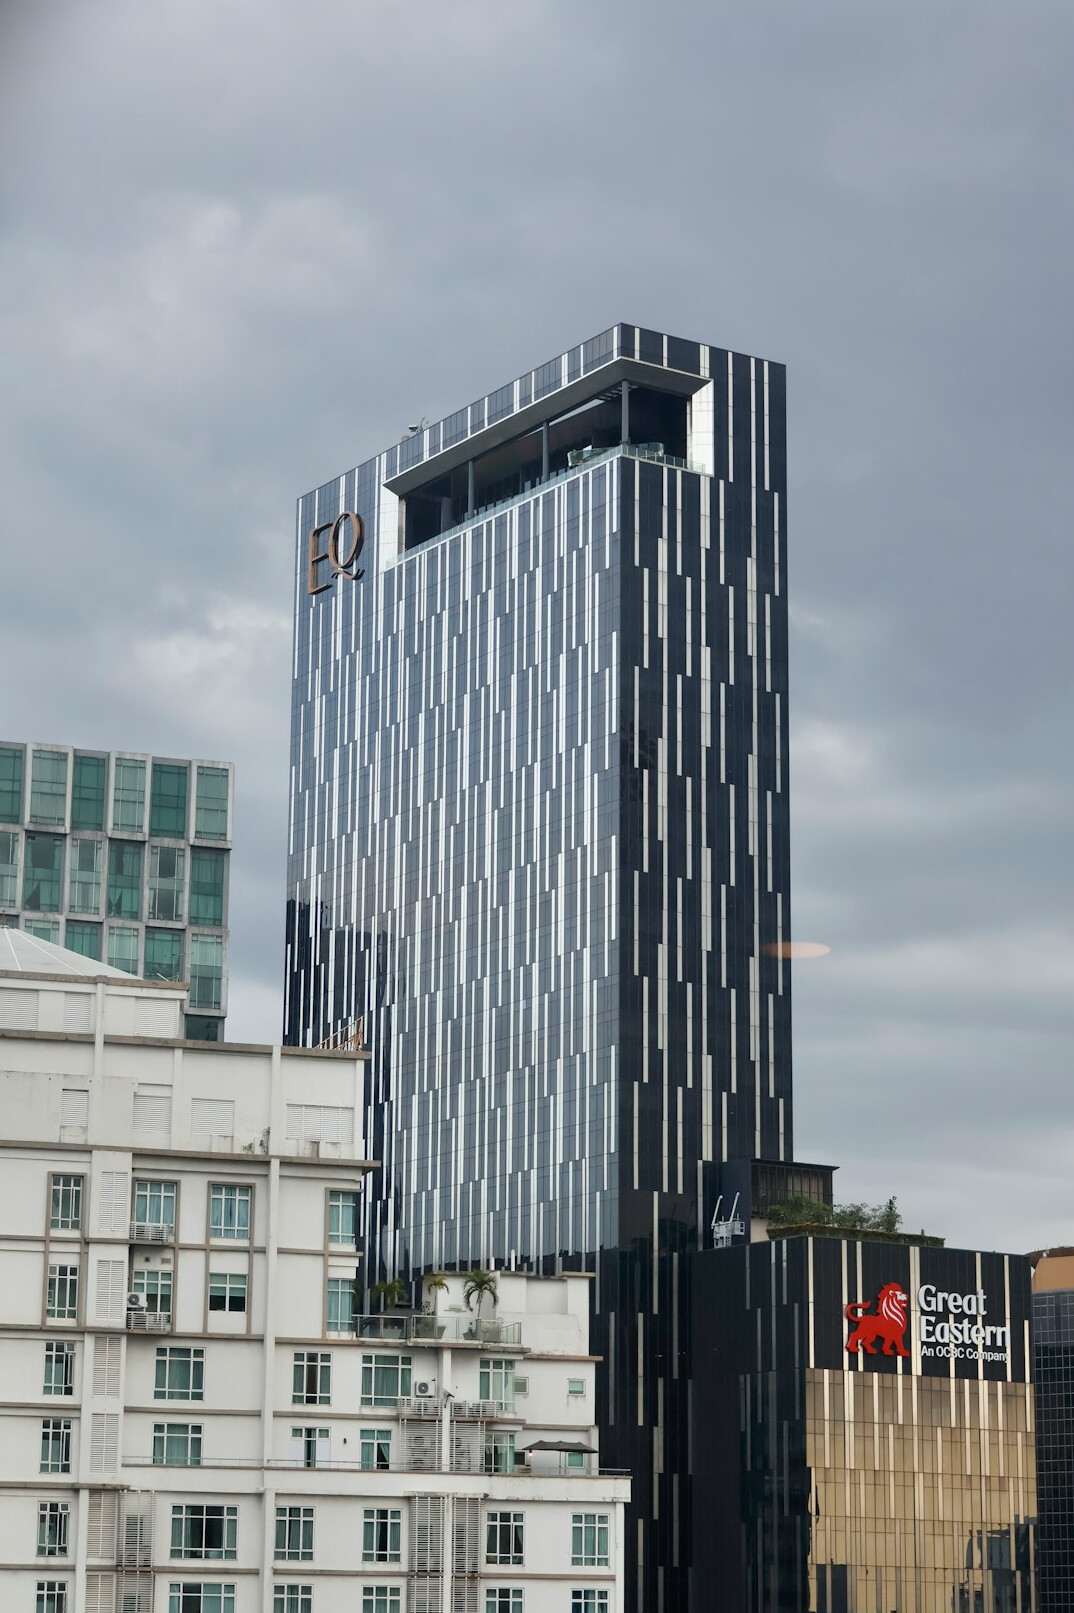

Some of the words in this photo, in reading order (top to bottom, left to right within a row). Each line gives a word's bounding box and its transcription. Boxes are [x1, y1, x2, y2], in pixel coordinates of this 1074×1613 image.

[308, 511, 365, 595] EQ
[919, 1285, 987, 1315] Great
[920, 1315, 1011, 1347] Eastern
[921, 1345, 934, 1357] An
[936, 1346, 964, 1358] OCBC
[966, 1348, 1009, 1363] Company
